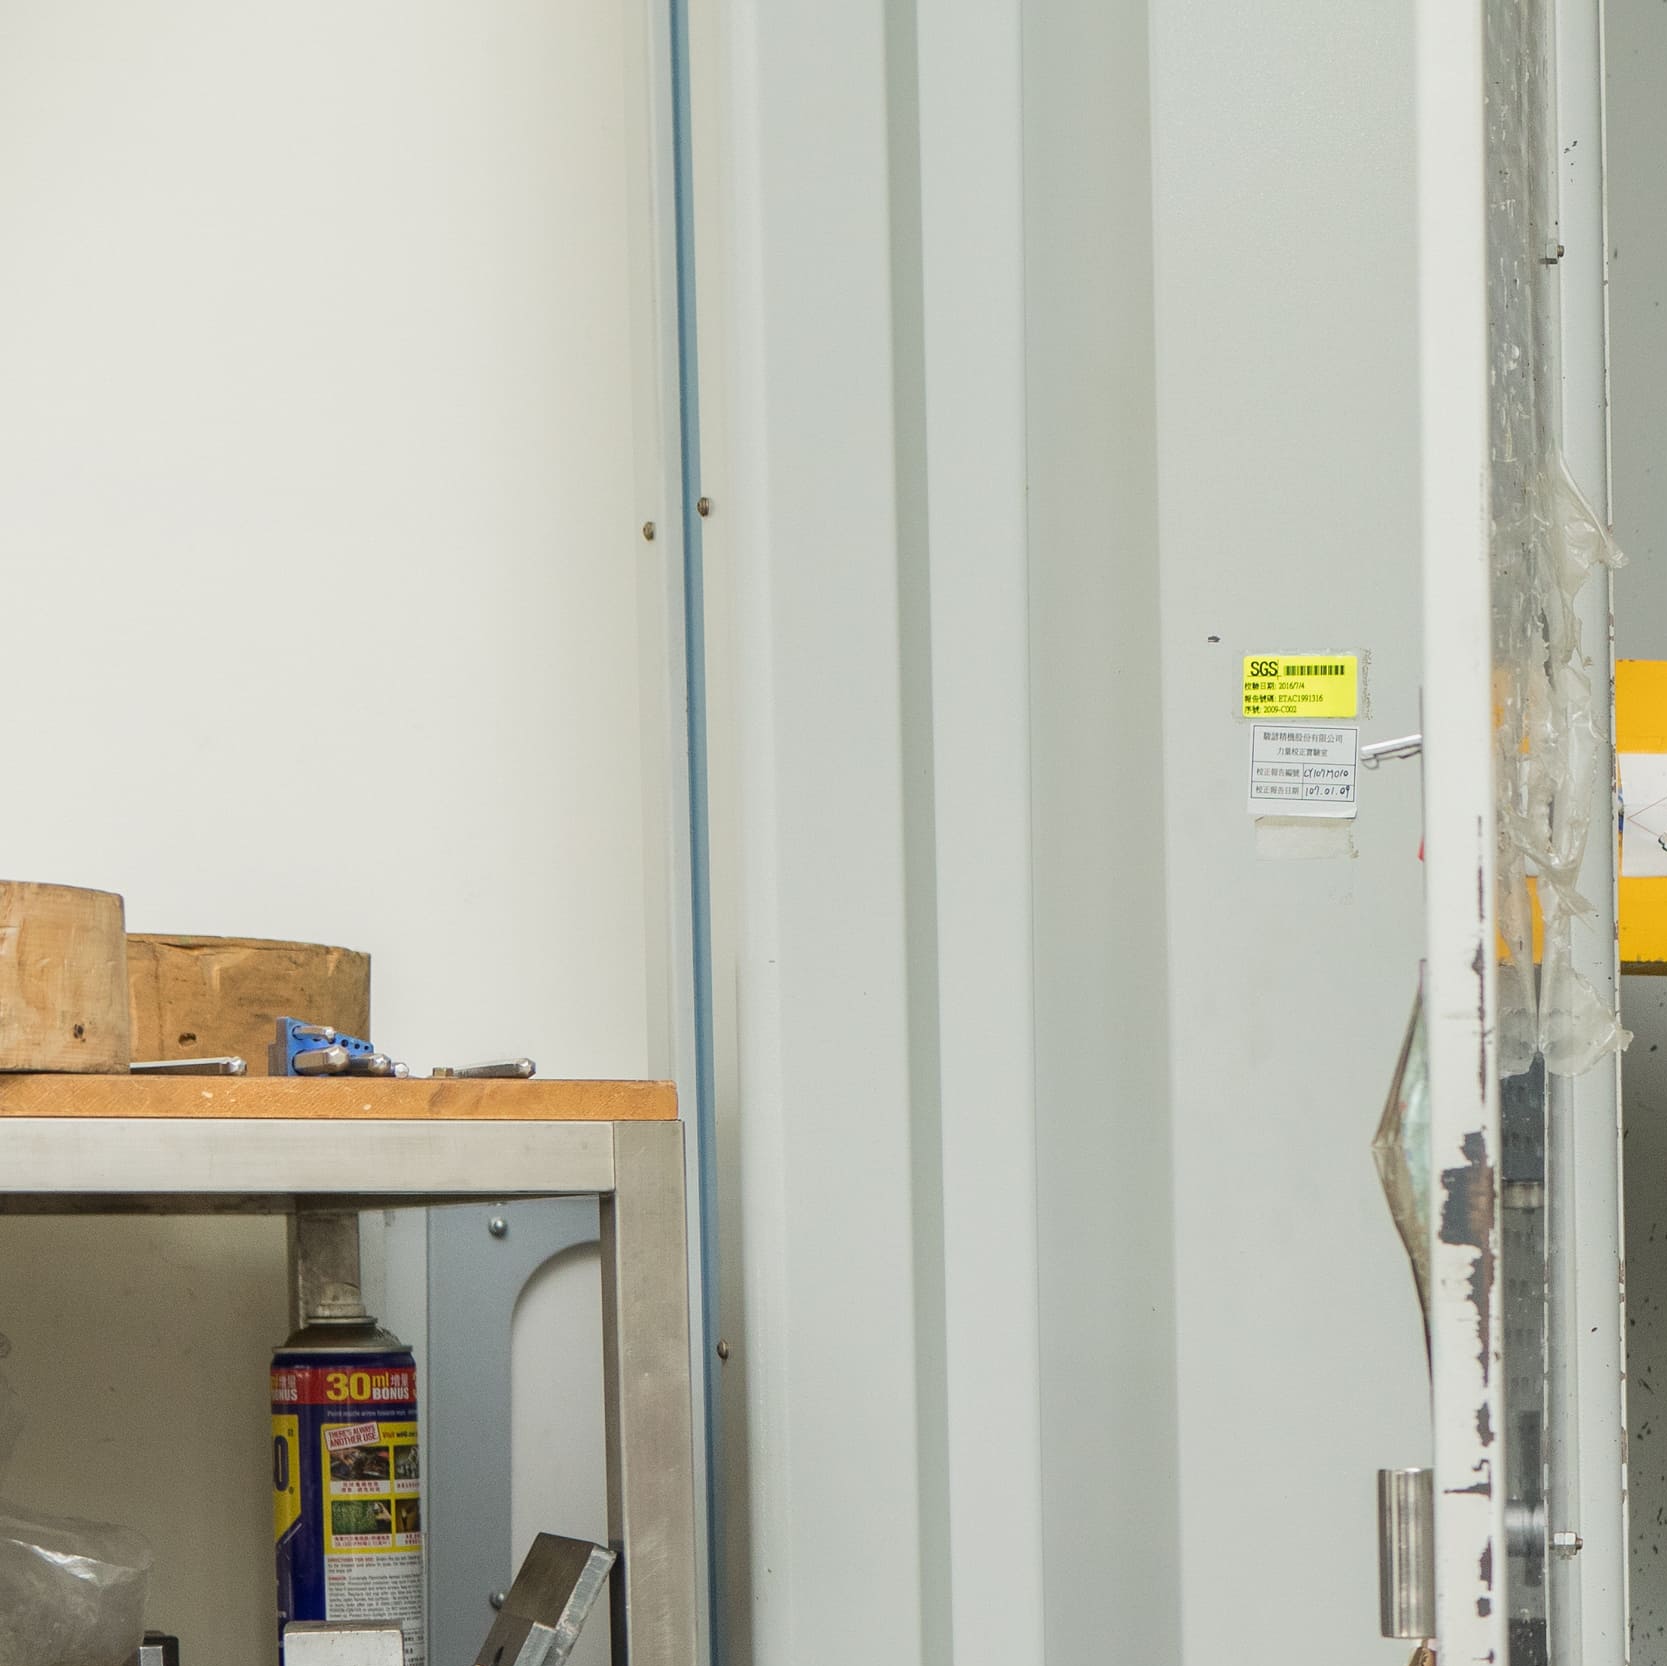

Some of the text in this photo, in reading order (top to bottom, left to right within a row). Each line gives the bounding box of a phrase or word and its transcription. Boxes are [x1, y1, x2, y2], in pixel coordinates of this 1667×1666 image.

[1250, 661, 1278, 677] SGS
[1279, 682, 1305, 690] 2016/7/4
[326, 1372, 372, 1401] 30
[372, 1372, 390, 1387] ml
[372, 1386, 409, 1400] BONUS
[353, 1424, 376, 1436] ALWAYS
[329, 1432, 377, 1448] ANOTHER USE
